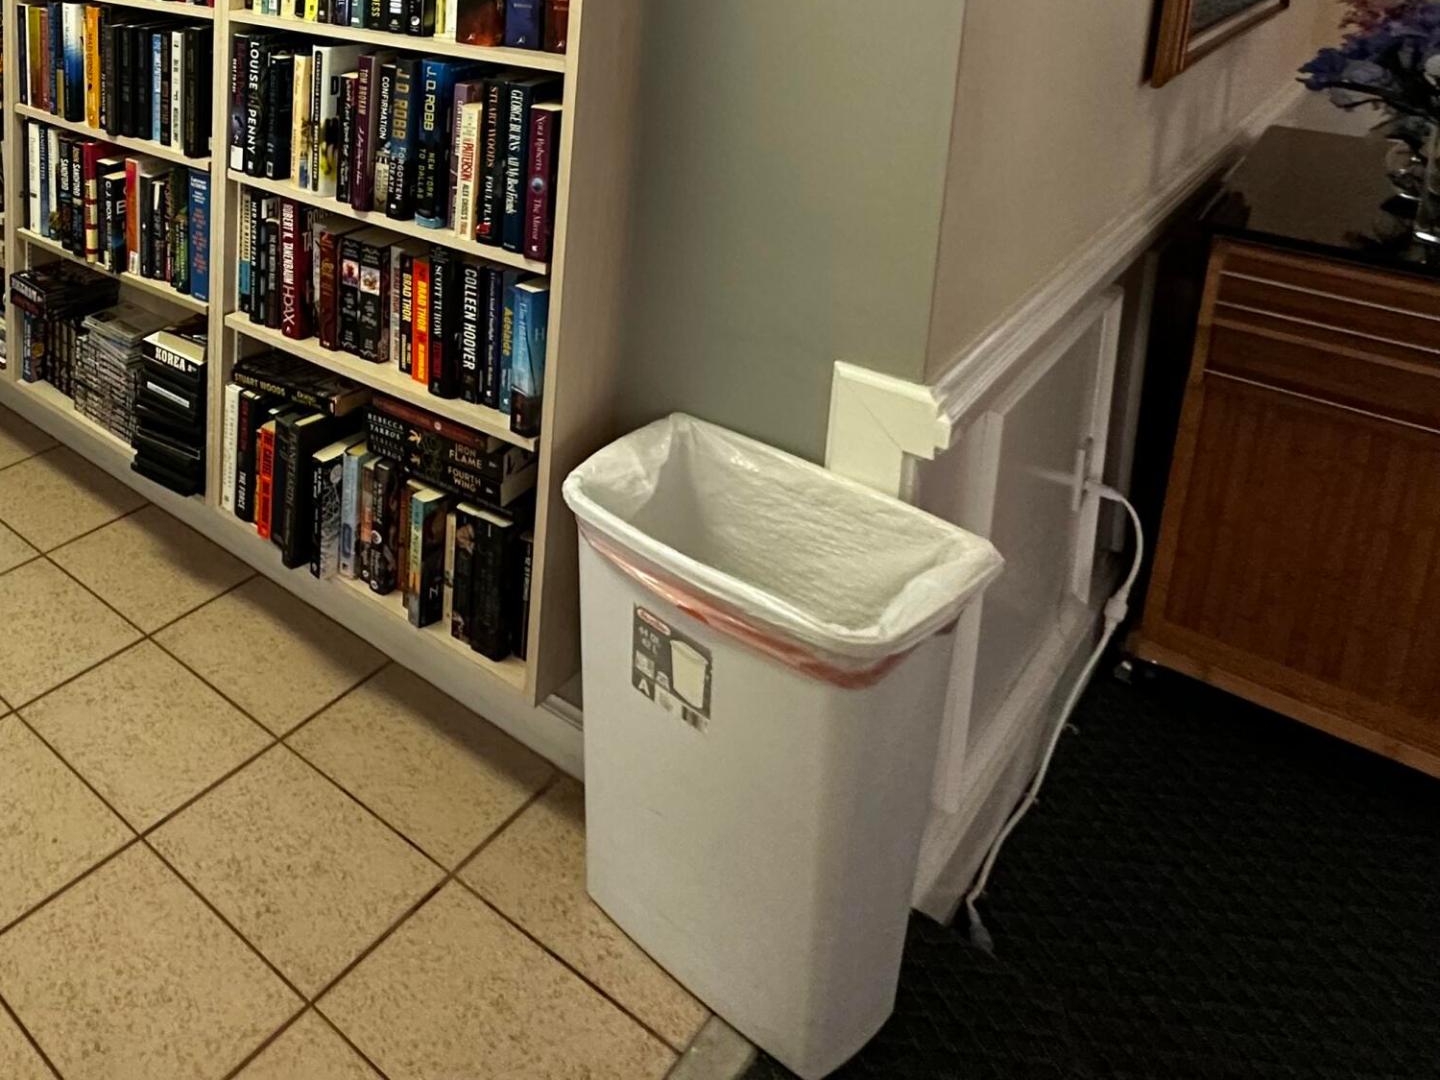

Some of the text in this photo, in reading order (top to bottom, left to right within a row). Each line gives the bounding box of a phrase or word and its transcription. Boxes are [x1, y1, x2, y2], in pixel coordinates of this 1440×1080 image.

[359, 69, 368, 84] TOM
[246, 41, 260, 155] LOUISE PENNY
[378, 76, 389, 140] CONFIRMATION
[423, 94, 435, 131] ROBB
[392, 99, 409, 140] ROBB
[486, 86, 499, 168] STUART WOODS
[508, 90, 523, 152] GEORGE BURNS
[460, 142, 473, 182] PATTERSON
[534, 115, 547, 171] Nora Roberts
[60, 158, 69, 191] SANDFORD
[72, 163, 80, 196] SANDFORD
[387, 162, 396, 193] DEATH
[395, 147, 406, 201] FORGOTTEN
[417, 148, 427, 200] TO DALLAS
[426, 153, 435, 198] NEW YORK
[461, 184, 469, 197] ALEX
[484, 176, 494, 202] FOUL
[504, 178, 517, 215] Best Friends
[531, 199, 542, 241] The Mirror
[282, 204, 294, 285] ROBERT TANENBAUM
[282, 285, 295, 325] HOAX
[402, 273, 412, 322] BRAD THOR
[417, 281, 427, 332] BRAD THOR
[433, 265, 443, 338] SCOTT TUROW
[462, 268, 477, 370] COLLEEN HOOVER
[502, 307, 513, 357] Adelaide
[155, 347, 186, 370] KOREA
[235, 373, 285, 396] STUART WOODS
[367, 412, 404, 431] REBECCA
[369, 423, 401, 441] YARROS
[448, 448, 483, 469] FLAME
[454, 443, 477, 457] IRON
[238, 471, 247, 511] THE FORCE
[286, 472, 296, 506] EARTH
[448, 465, 481, 485] FOURTH
[452, 476, 477, 493] WING
